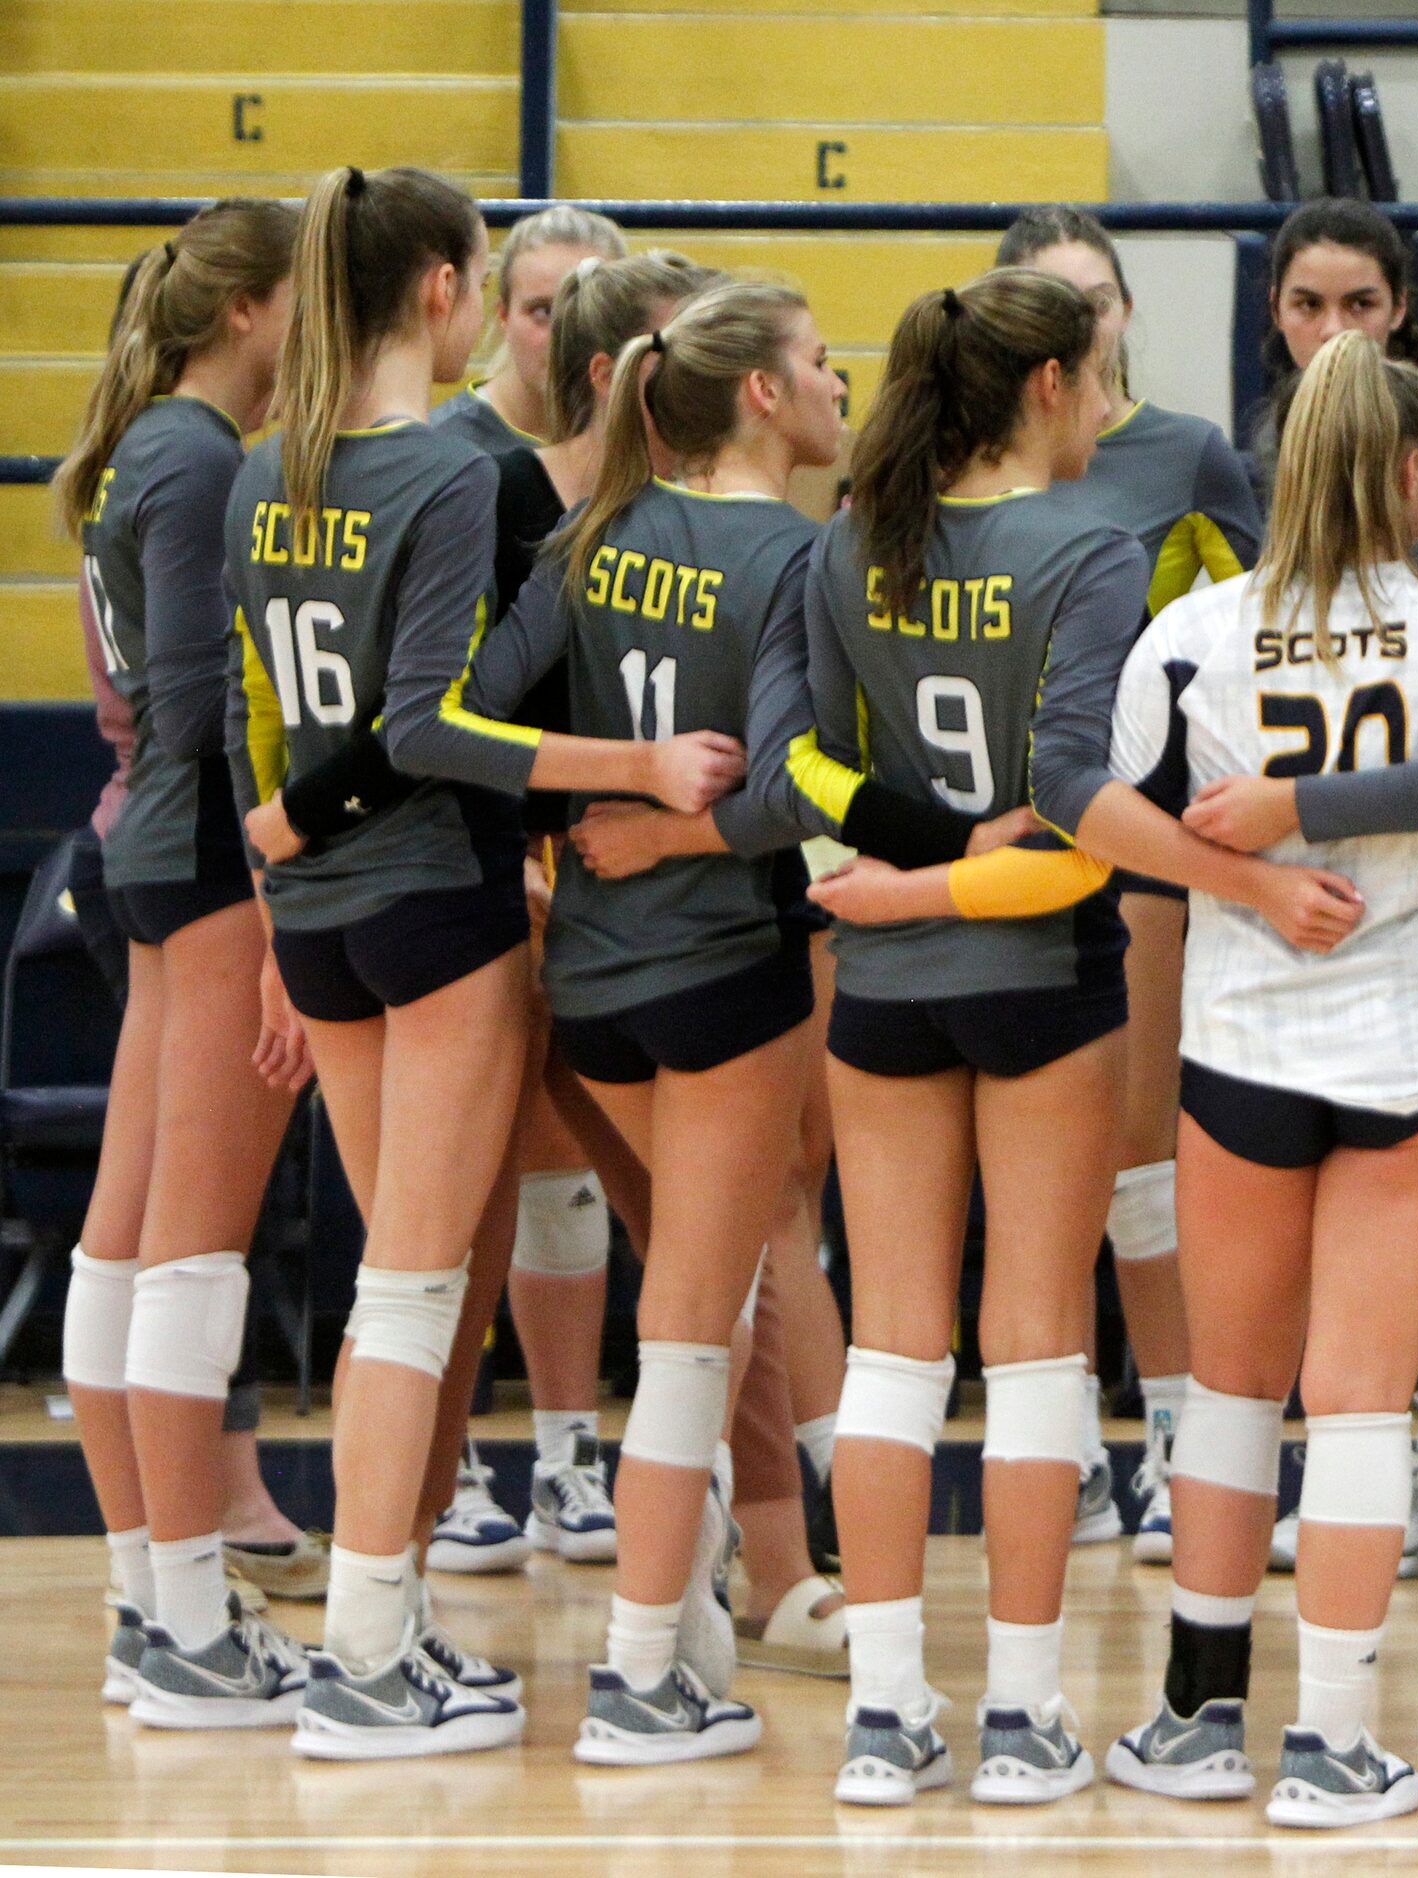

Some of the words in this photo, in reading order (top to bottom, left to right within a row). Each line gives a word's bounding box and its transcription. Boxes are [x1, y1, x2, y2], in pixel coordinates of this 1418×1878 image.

[233, 94, 263, 142] C
[817, 141, 847, 188] C
[251, 501, 371, 571] SCOTS
[586, 544, 724, 630] SCOTS
[265, 598, 356, 726] 16
[1255, 621, 1408, 672] SCOTS
[619, 648, 677, 742] 11
[1259, 680, 1410, 777] 20
[916, 674, 995, 814] 9
